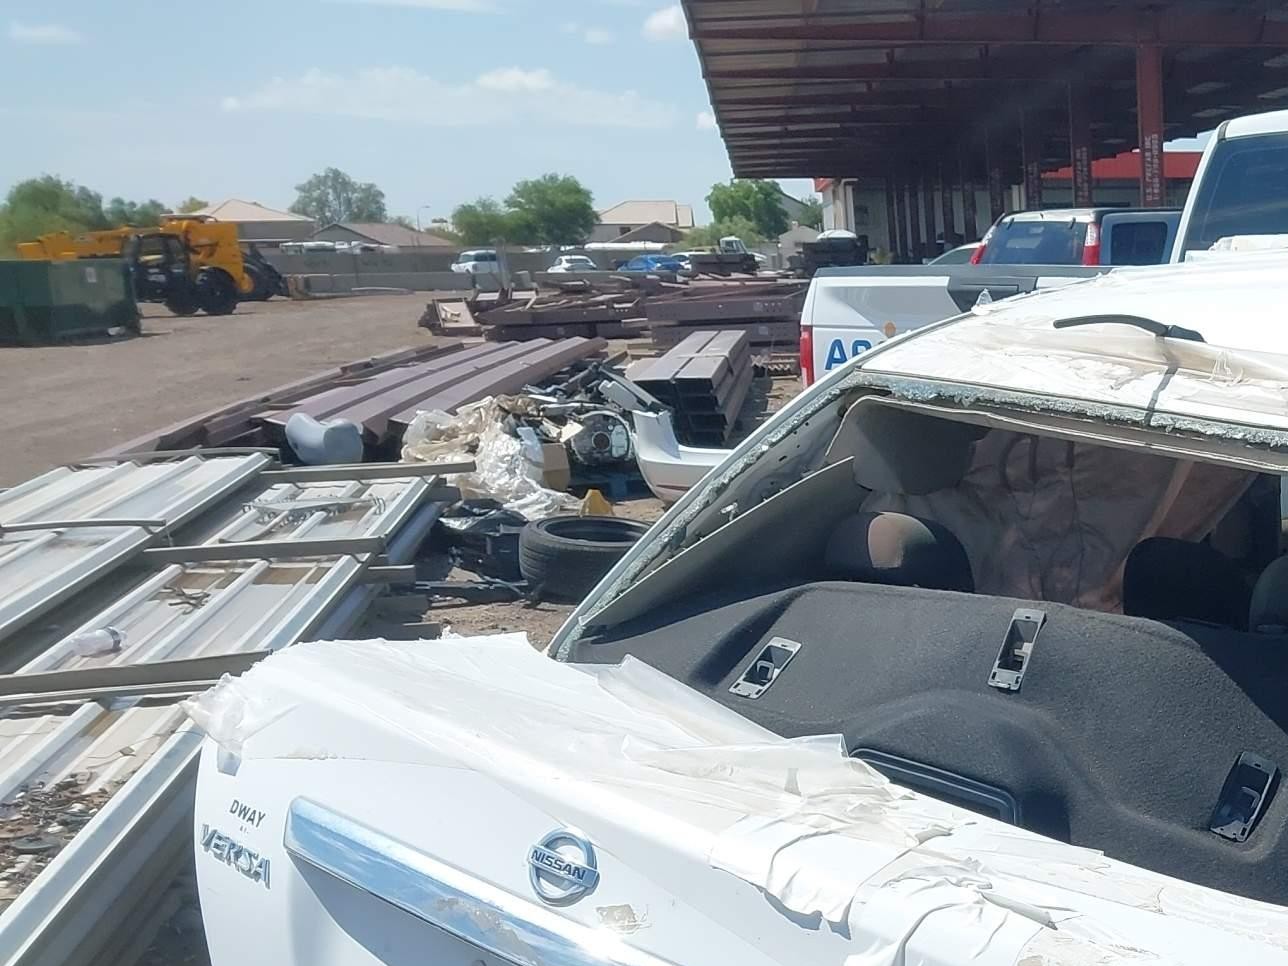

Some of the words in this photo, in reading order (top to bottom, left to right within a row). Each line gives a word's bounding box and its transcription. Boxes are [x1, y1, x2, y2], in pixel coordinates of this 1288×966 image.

[229, 799, 266, 828] DWAY
[200, 823, 271, 889] VERSA
[530, 849, 586, 880] NISSAN
